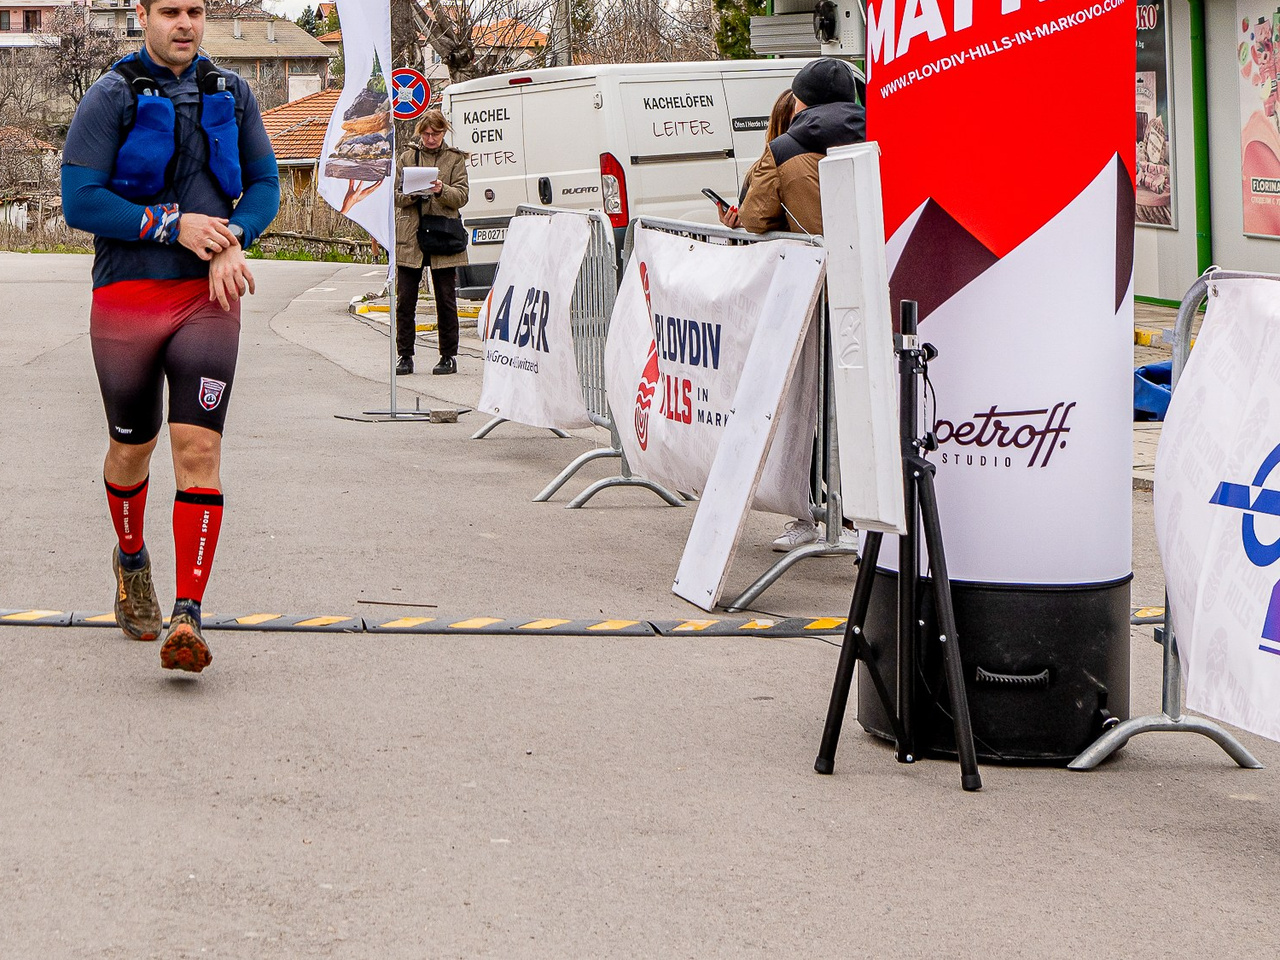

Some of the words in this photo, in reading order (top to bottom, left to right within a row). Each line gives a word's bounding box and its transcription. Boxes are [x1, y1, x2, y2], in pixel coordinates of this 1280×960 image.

[643, 93, 715, 110] KACHELÖFEN
[463, 107, 511, 125] KACHEL
[471, 128, 503, 144] ÖFEN
[652, 119, 715, 137] LEITER
[561, 186, 599, 195] DUCATO
[654, 313, 722, 370] PLOVDIV
[697, 387, 709, 402] IN
[941, 452, 1012, 468] STUDIO
[201, 510, 210, 533] SPORT
